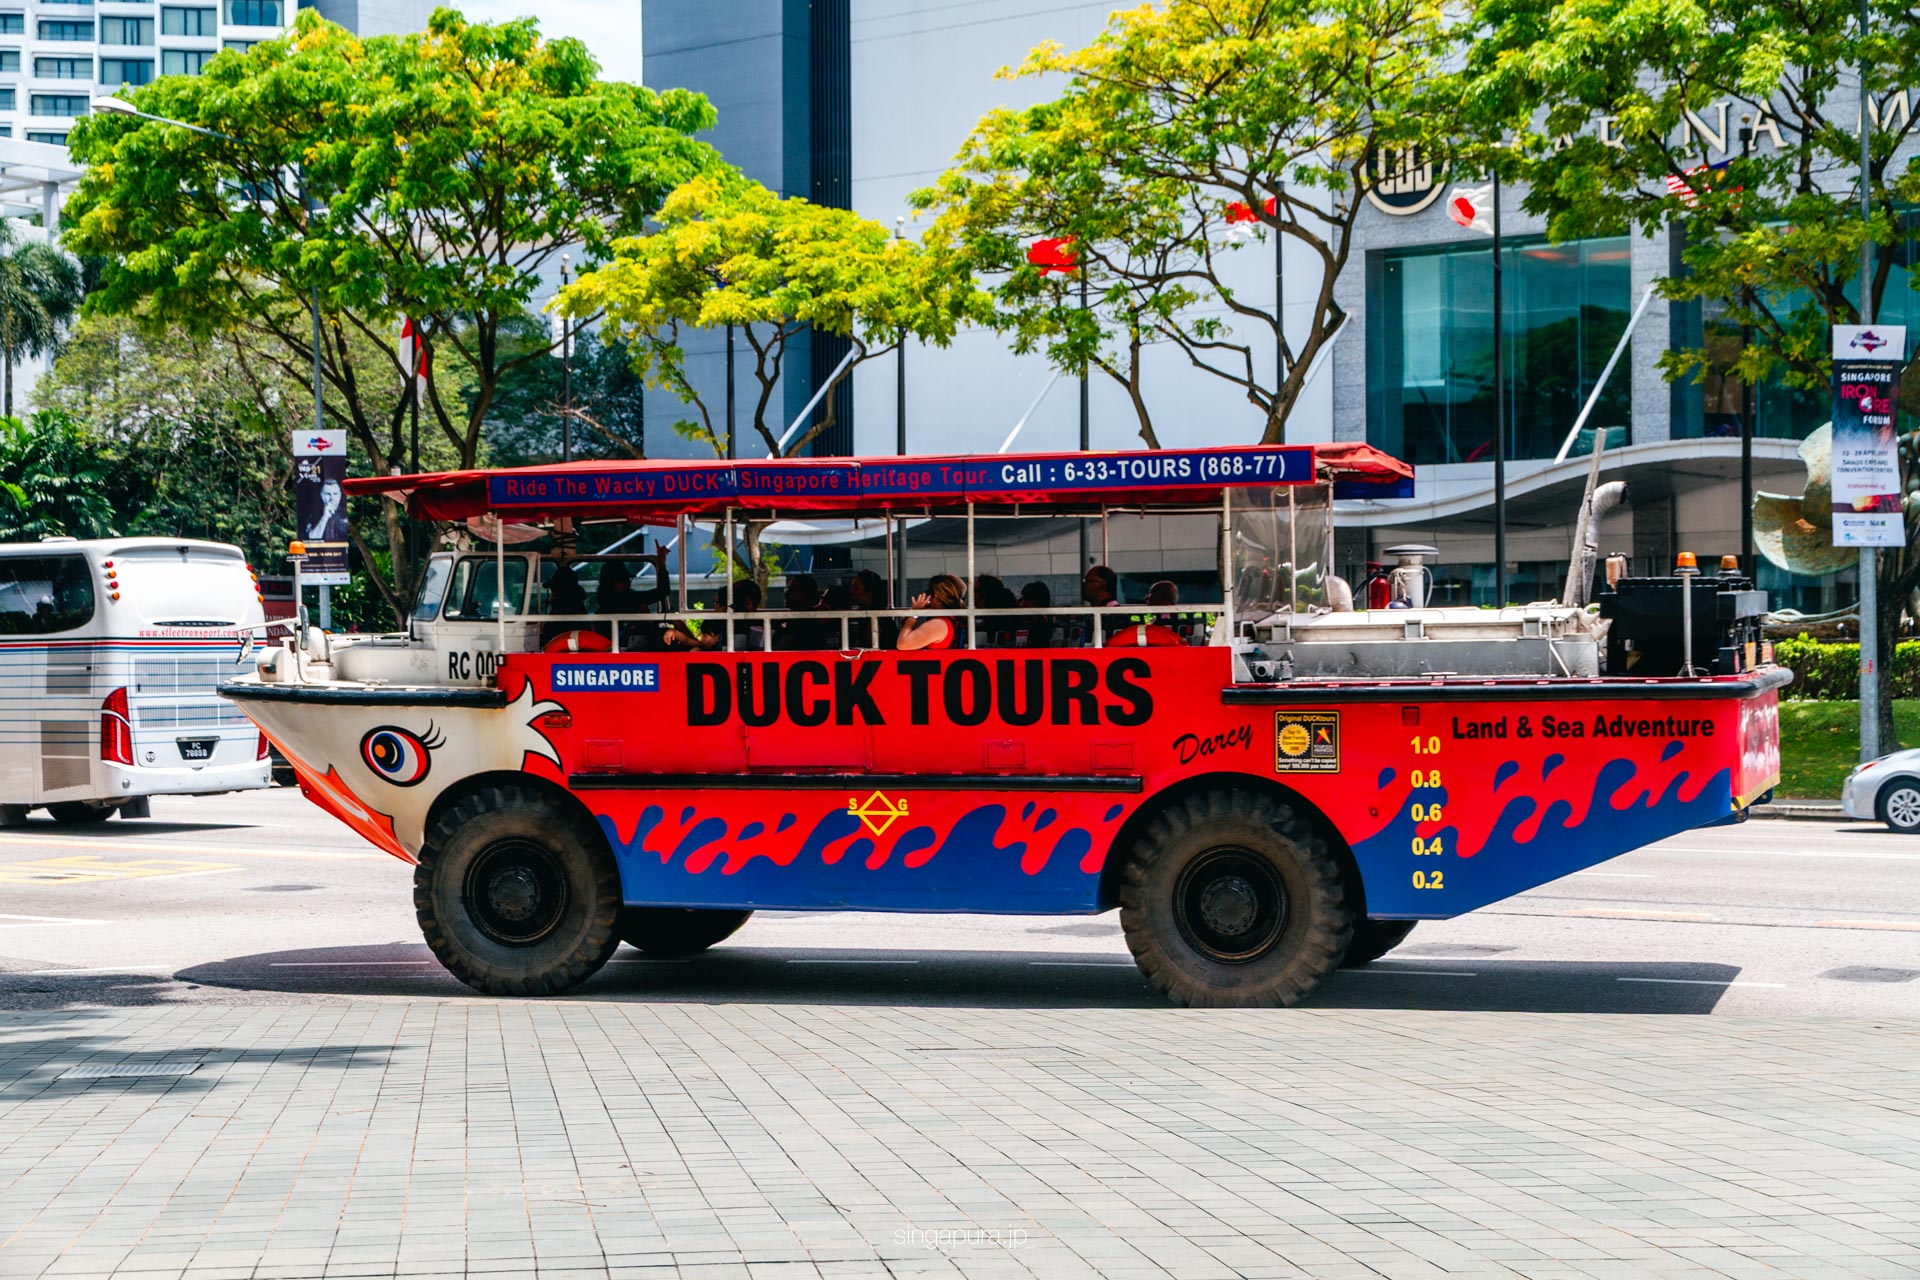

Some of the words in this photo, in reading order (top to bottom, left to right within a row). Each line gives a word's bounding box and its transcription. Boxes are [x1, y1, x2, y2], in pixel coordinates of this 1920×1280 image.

[1841, 372, 1892, 382] SINGAPORE
[1841, 384, 1877, 399] IRON
[1863, 415, 1891, 425] FORUM
[506, 479, 547, 496] Ride
[554, 478, 588, 495] The
[594, 477, 655, 497] Wacky
[664, 473, 719, 493] DUCK
[740, 471, 840, 493] Singapore
[847, 469, 932, 490] Heritage
[940, 467, 993, 485] Tour.
[1001, 464, 1041, 483] Call
[1064, 458, 1191, 481] 6-33-TOURS
[1200, 454, 1286, 481] (868-77)
[139, 627, 250, 640] www.stleetransport.comsg
[449, 651, 471, 680] RC
[556, 669, 655, 686] SINGAPORE
[686, 660, 886, 727] DUCK
[897, 657, 1154, 727] TOURS
[1452, 716, 1507, 739] Land
[1516, 716, 1533, 738] &
[1542, 715, 1585, 738] Sea
[1592, 715, 1715, 738] Adventure
[1172, 724, 1254, 765] Darcy
[1410, 735, 1441, 754] 1.0
[1411, 770, 1441, 788] 0.8
[849, 797, 858, 810] S
[897, 798, 908, 811] G
[1411, 803, 1442, 821] 0.6
[1412, 837, 1443, 855] 0.4
[1412, 870, 1444, 889] 0.2
